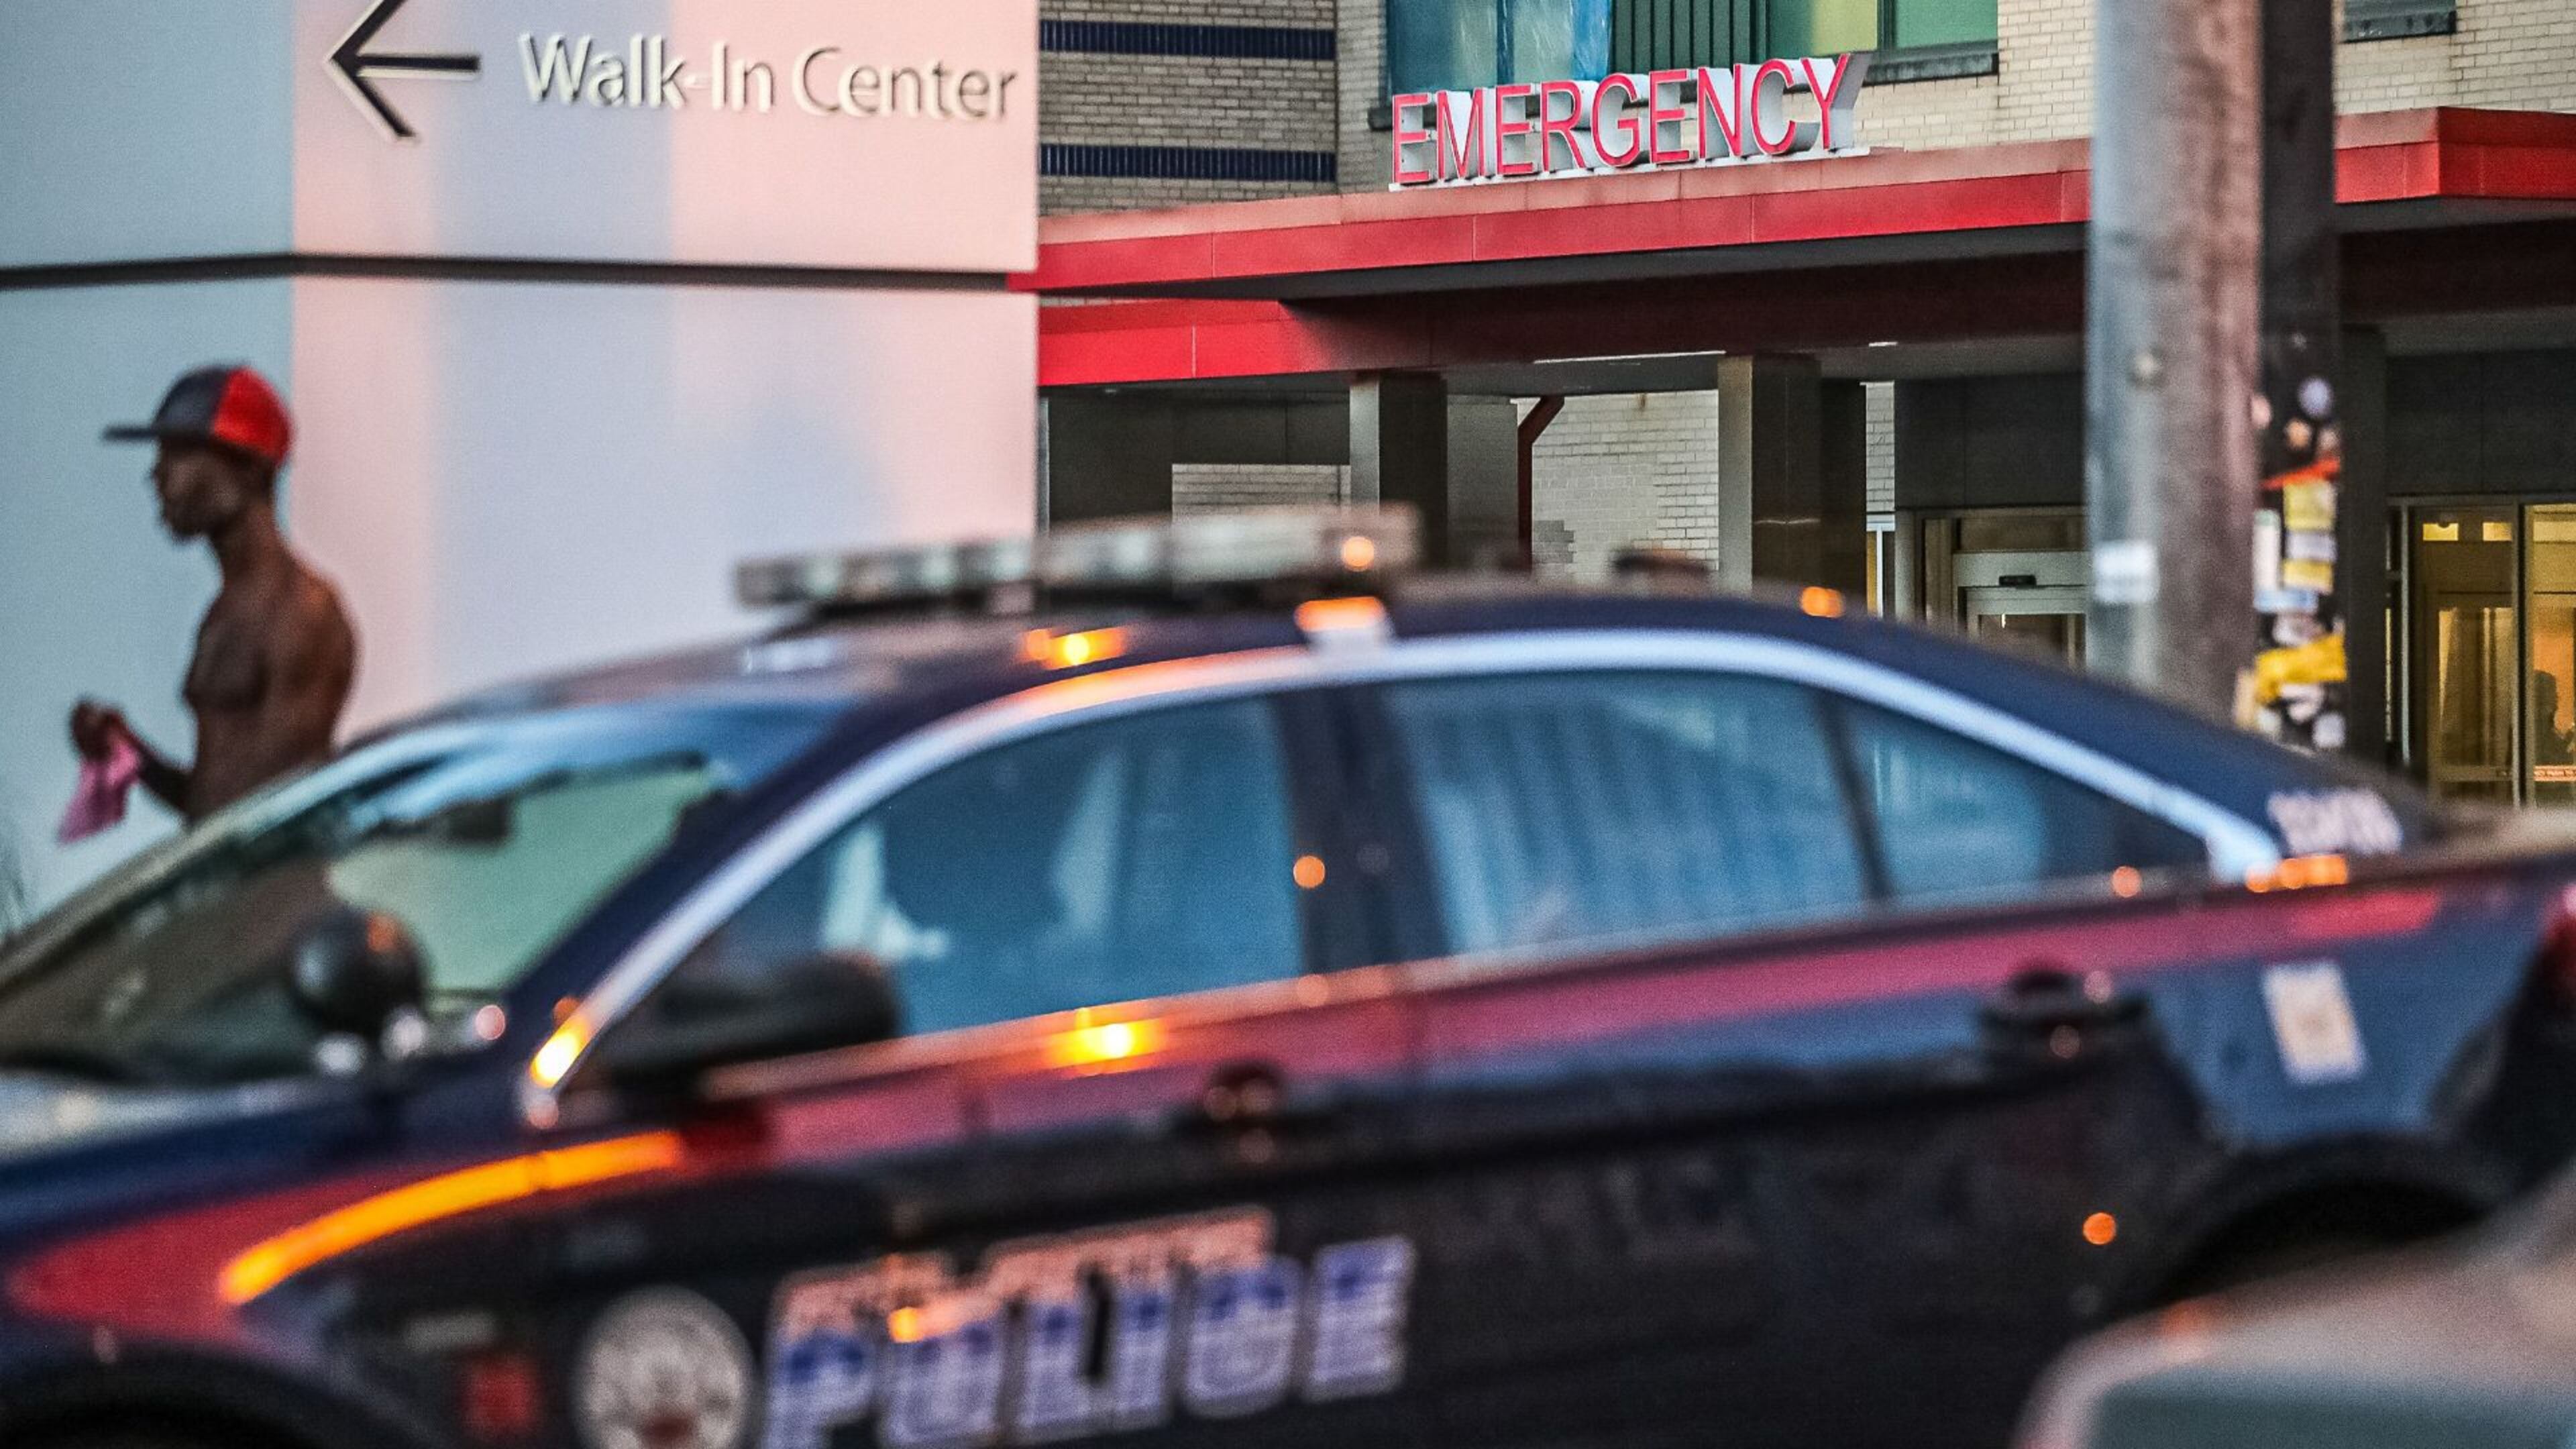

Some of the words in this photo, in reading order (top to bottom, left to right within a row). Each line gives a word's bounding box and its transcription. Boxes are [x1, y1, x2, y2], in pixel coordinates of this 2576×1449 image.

[518, 32, 775, 113] Walk-In
[792, 45, 1018, 120] Center
[1392, 53, 1856, 184] EMERGENCY
[762, 1236, 1413, 1449] POLICE
